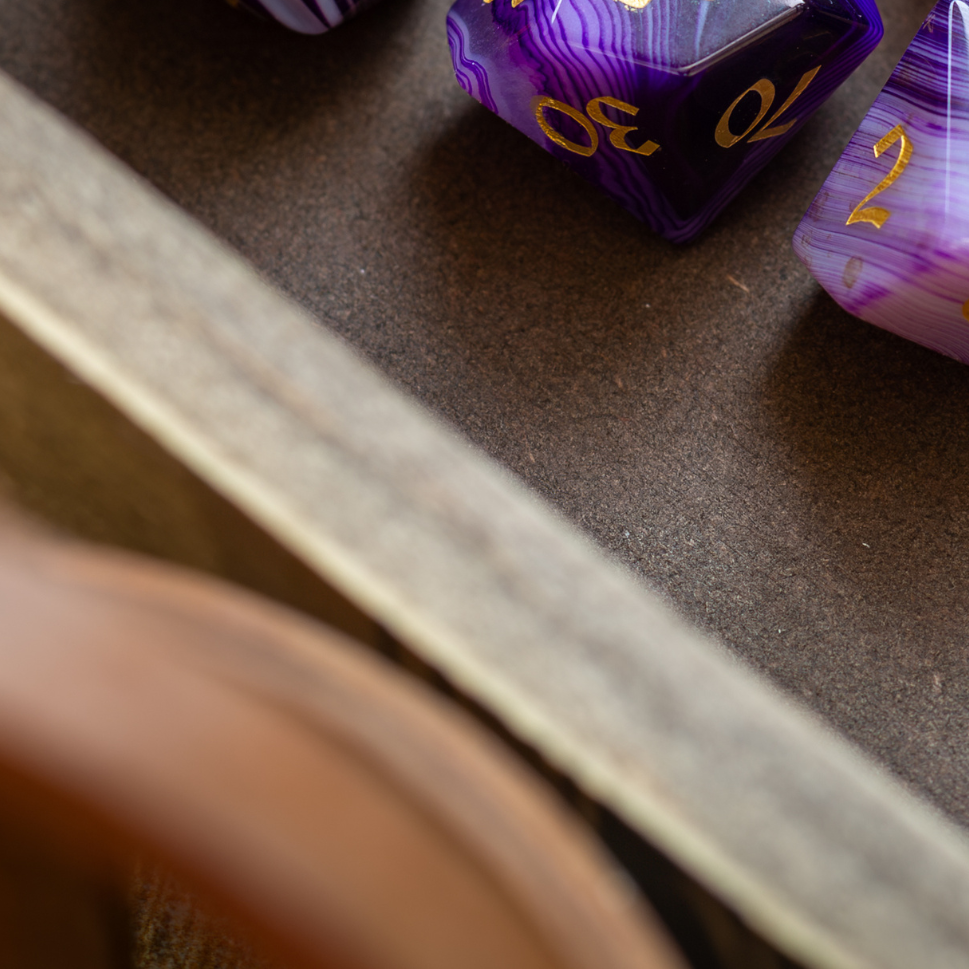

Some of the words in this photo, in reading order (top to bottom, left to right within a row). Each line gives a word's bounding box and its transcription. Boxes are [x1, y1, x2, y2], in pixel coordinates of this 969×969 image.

[534, 95, 662, 158] 30
[714, 64, 822, 149] 70
[846, 123, 914, 230] 2
